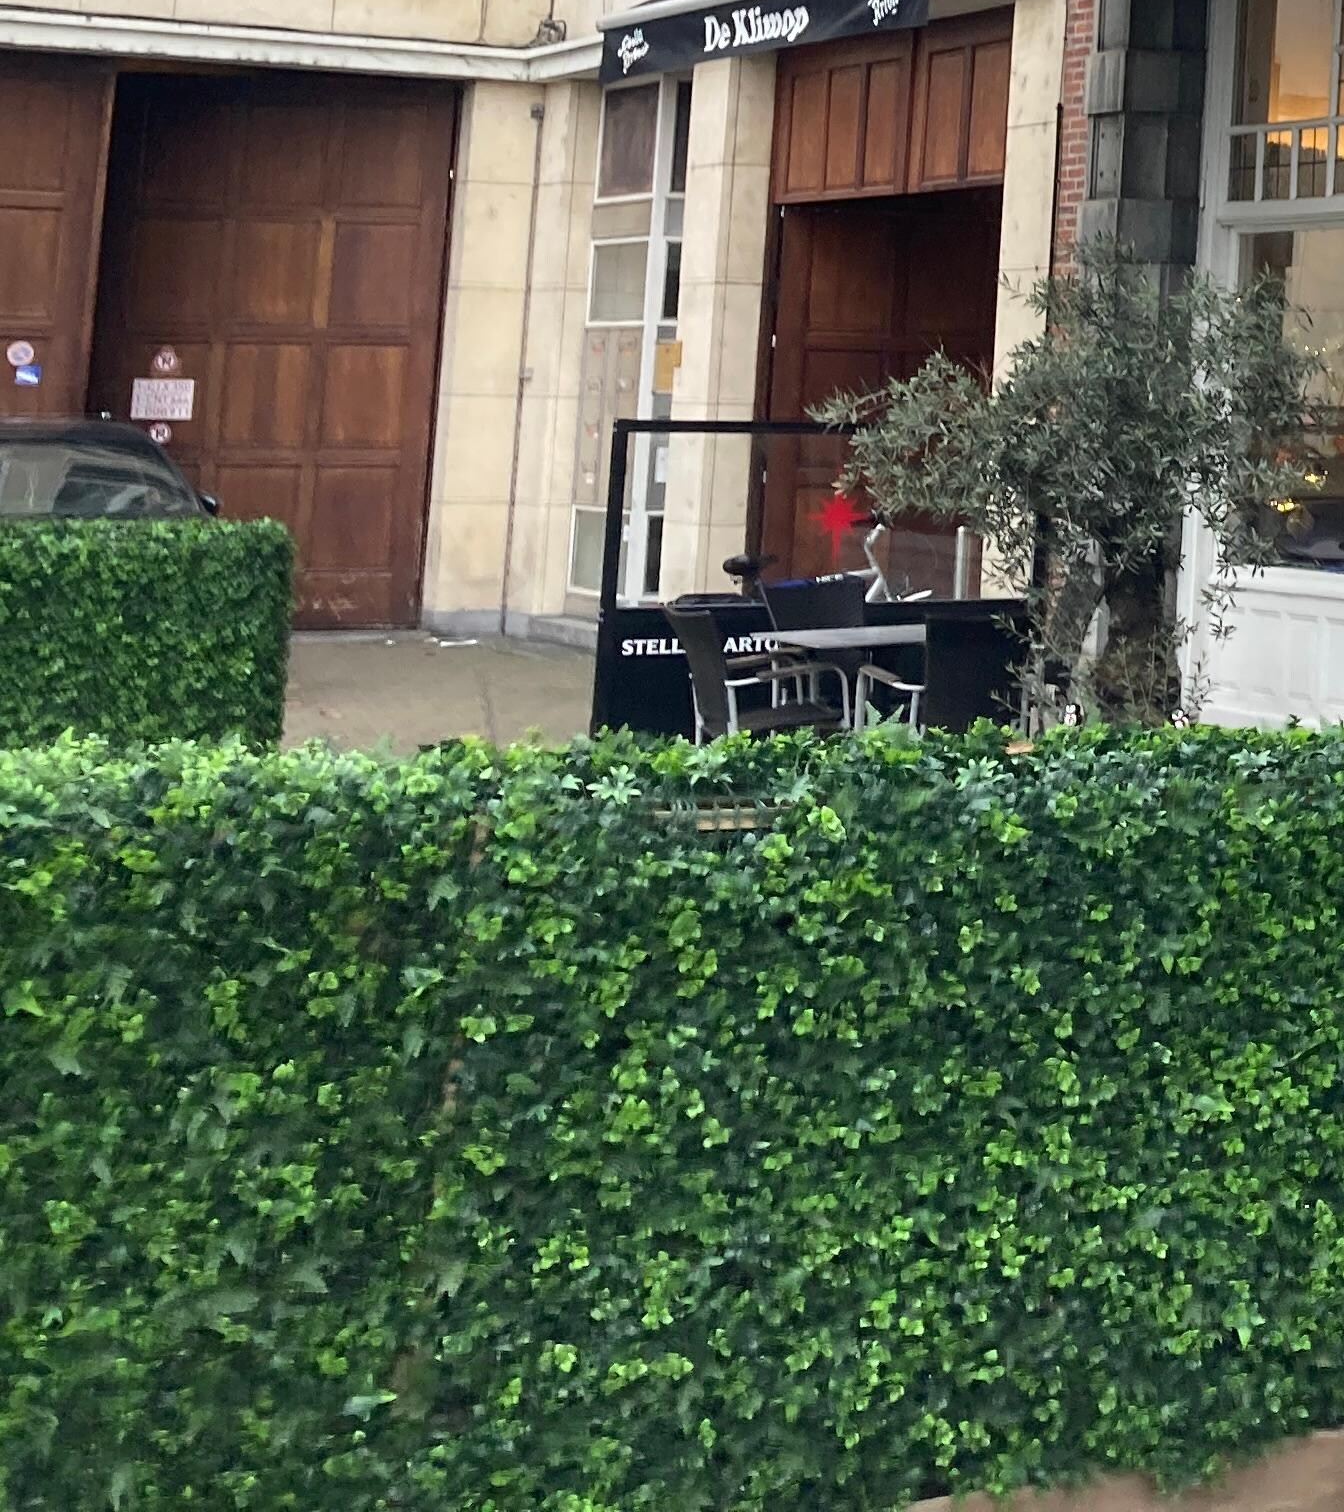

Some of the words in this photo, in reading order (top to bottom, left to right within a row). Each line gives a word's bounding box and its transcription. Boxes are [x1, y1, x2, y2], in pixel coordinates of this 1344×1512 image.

[703, 15, 731, 52] De
[731, 5, 810, 47] Klimop
[621, 638, 687, 656] STELL
[722, 636, 780, 653] ARTO
